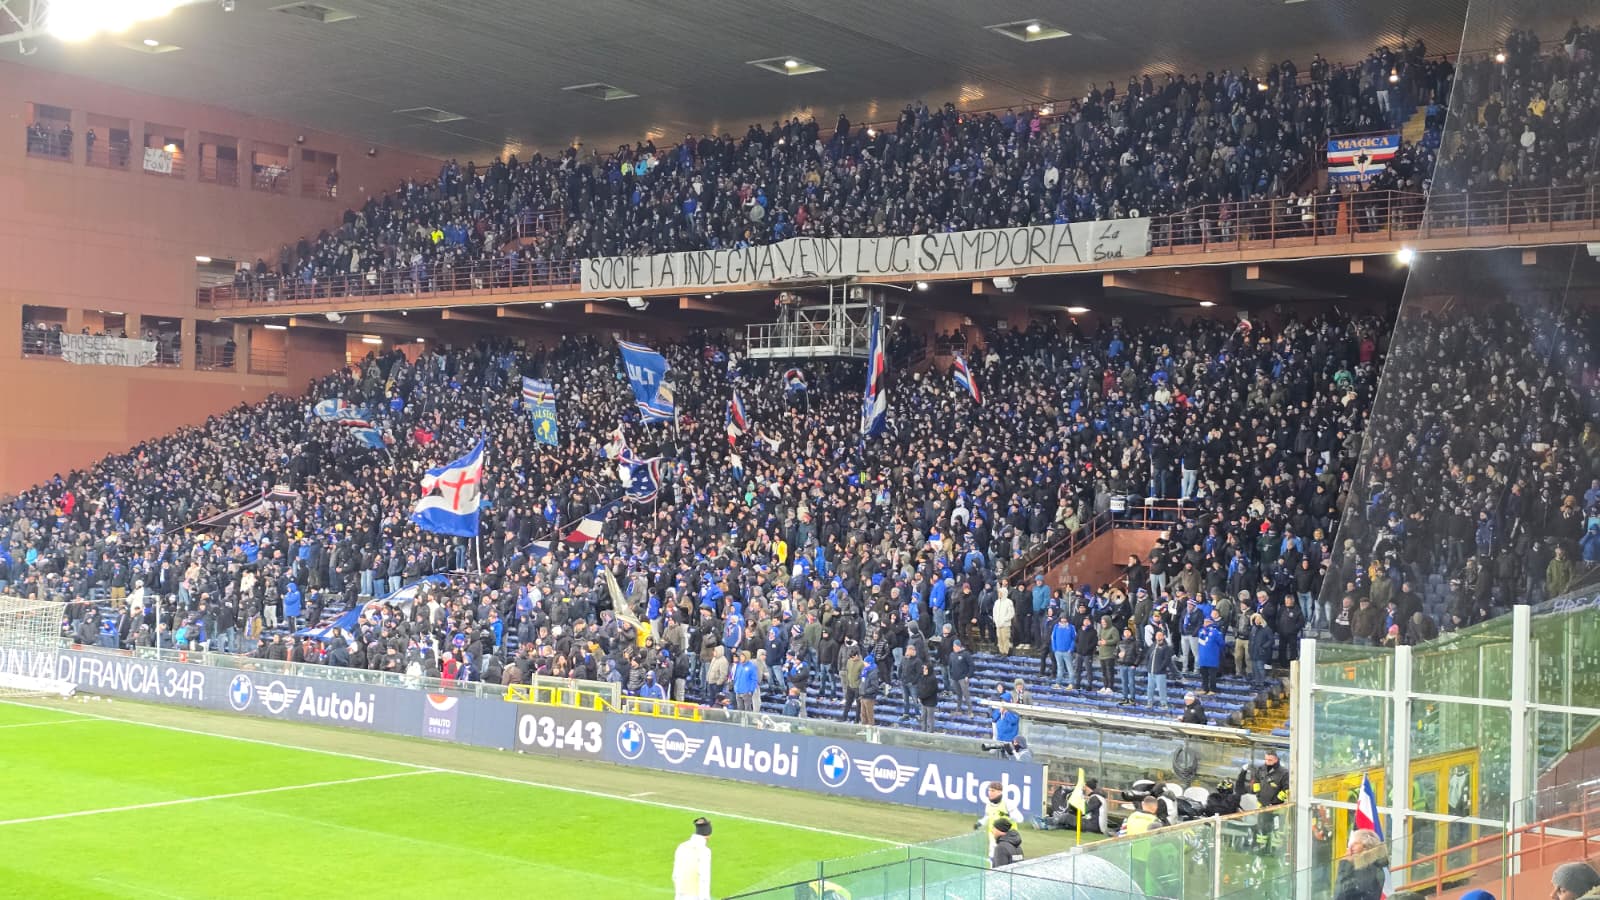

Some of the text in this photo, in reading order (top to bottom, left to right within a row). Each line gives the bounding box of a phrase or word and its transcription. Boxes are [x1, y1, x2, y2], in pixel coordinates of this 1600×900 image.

[1337, 136, 1389, 149] MAGICA
[683, 244, 775, 285] INDEGNA
[776, 238, 842, 275] VENDI
[919, 224, 1081, 271] SAMPDORIA
[1094, 243, 1124, 262] Sud
[58, 655, 77, 683] DI
[79, 657, 160, 695] FRANCIA
[164, 667, 205, 700] 34R
[297, 686, 374, 724] Autobi
[518, 714, 603, 753] 03:43
[703, 736, 799, 778] Autobi
[874, 767, 897, 780] MINI
